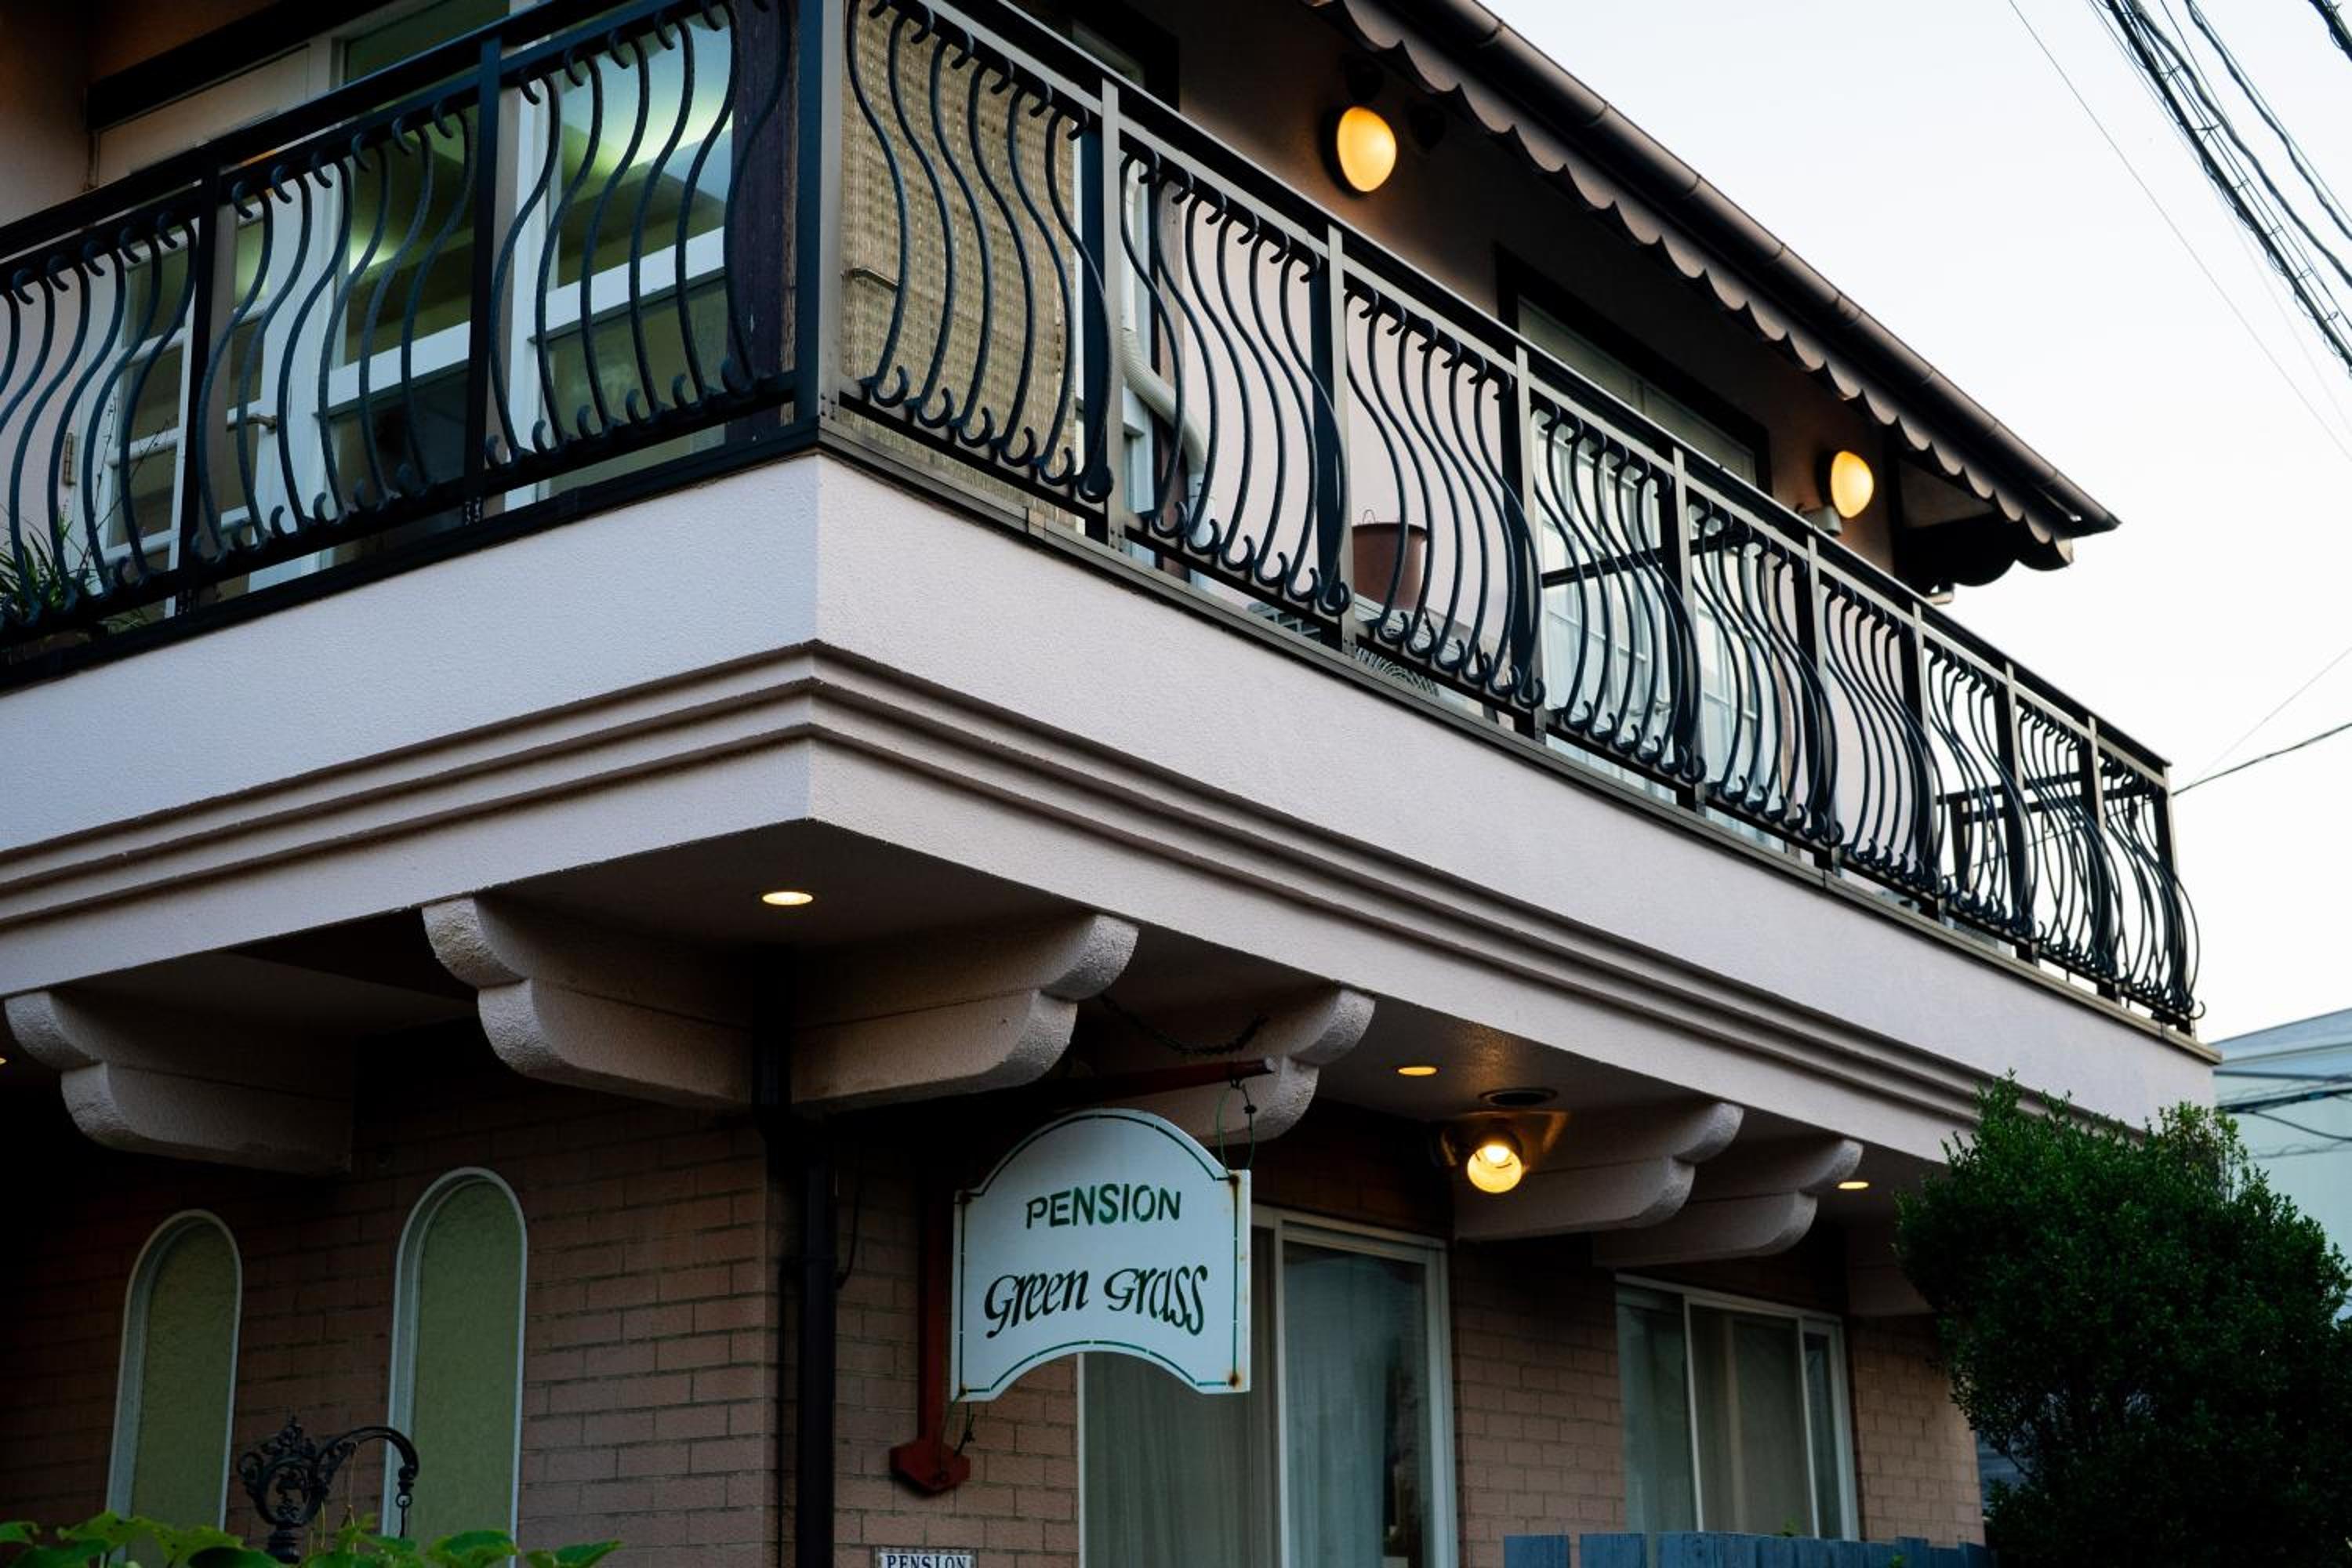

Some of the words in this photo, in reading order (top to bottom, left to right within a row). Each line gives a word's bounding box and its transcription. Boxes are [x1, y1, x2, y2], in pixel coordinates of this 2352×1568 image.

[1025, 1183, 1181, 1229] PENSION
[984, 1268, 1089, 1339] Green
[1103, 1265, 1208, 1336] Grass
